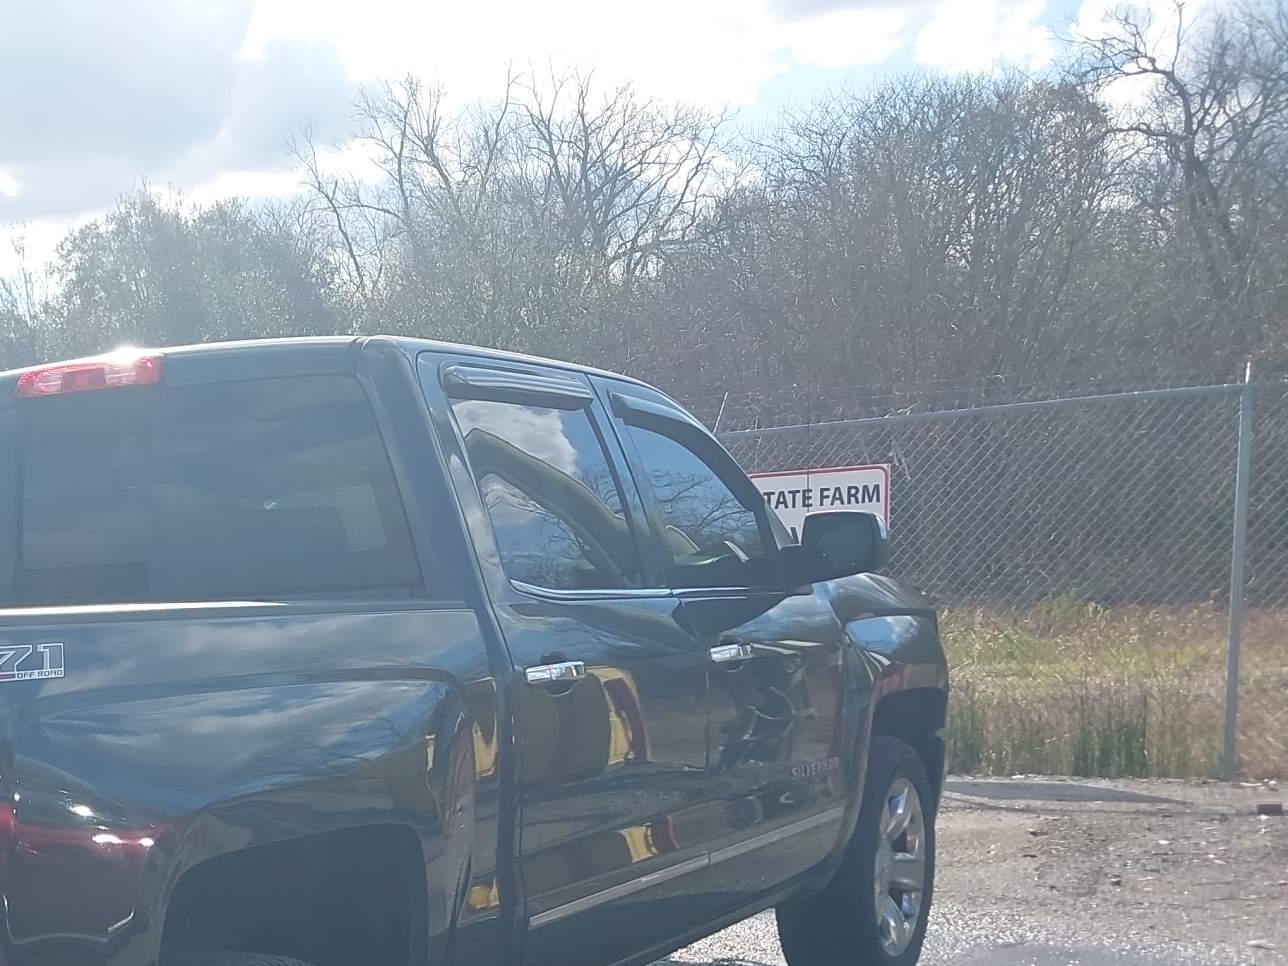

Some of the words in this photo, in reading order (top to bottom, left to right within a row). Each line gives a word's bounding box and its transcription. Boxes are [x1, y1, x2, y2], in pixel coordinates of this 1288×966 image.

[763, 489, 813, 510] TATE
[819, 483, 881, 507] FARM
[16, 671, 36, 680] OFF
[37, 669, 64, 679] ROAD
